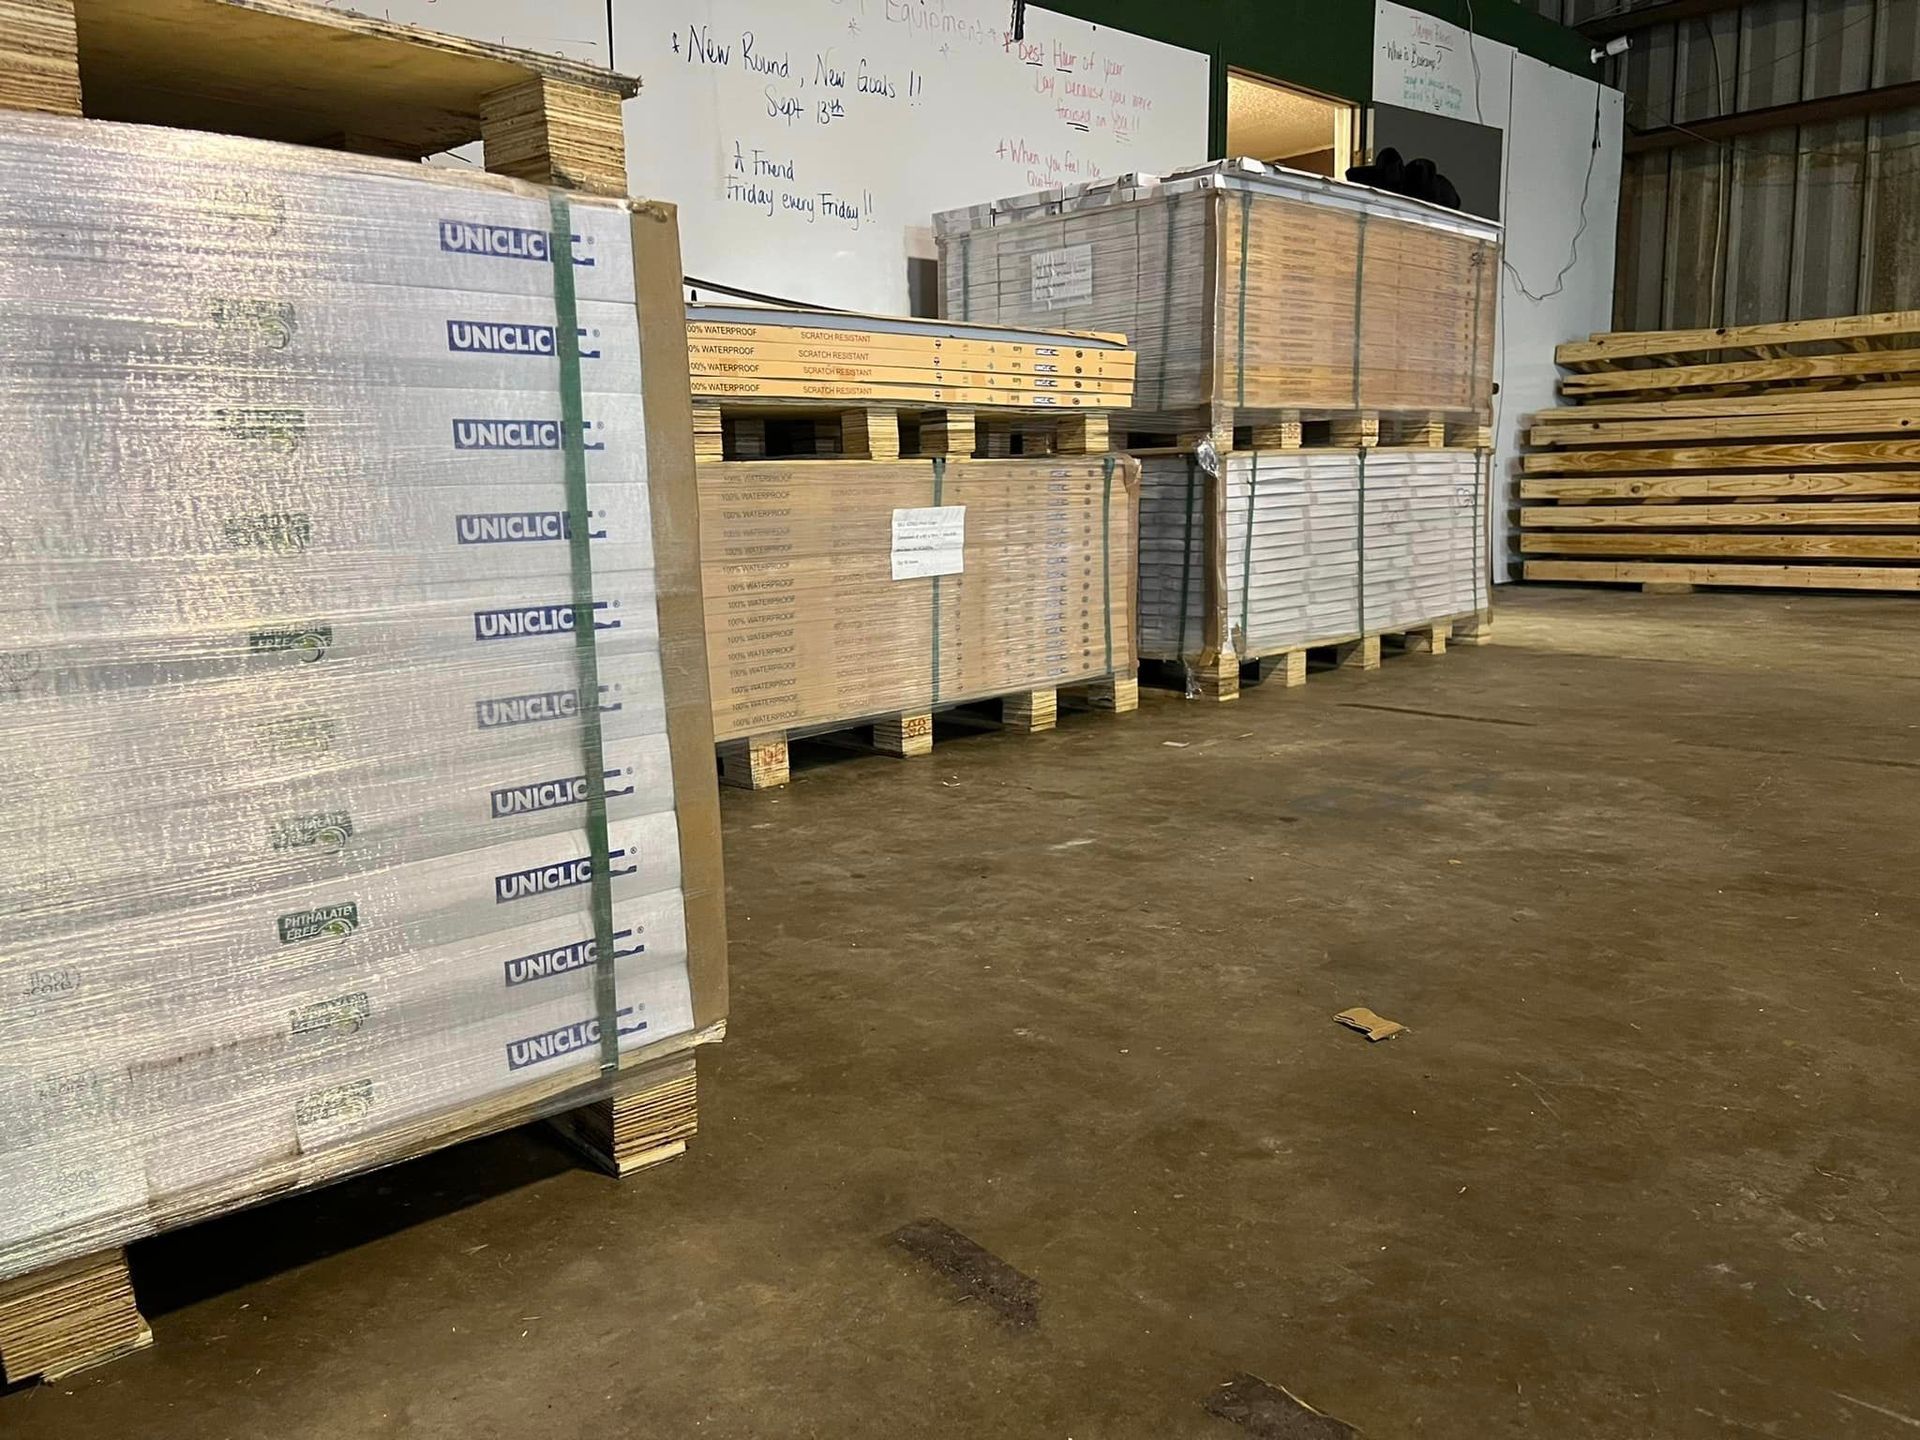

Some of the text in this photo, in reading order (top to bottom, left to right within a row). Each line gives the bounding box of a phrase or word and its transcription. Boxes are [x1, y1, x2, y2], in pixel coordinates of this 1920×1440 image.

[688, 24, 730, 65] New
[814, 48, 845, 88] New
[856, 58, 896, 98] Goals
[765, 84, 845, 126] Sept 13th
[751, 149, 795, 181] Friend
[722, 174, 773, 216] Friday
[782, 193, 815, 223] every
[817, 193, 860, 231] Friday
[444, 222, 547, 258] UNICLIC
[451, 323, 553, 353] UNICLIC
[705, 326, 757, 337] WATERPROOF
[801, 331, 871, 343] SCRATCH RESISTANT
[702, 345, 755, 355] WATERPROOF
[798, 349, 869, 361] SCRATCH RESISTANT
[707, 363, 759, 373] WATERPROOF
[803, 366, 872, 377] SCRATCH RESISTANT
[708, 383, 760, 393] WATERPROOF
[803, 385, 872, 396] SCRATCH RESISTANT
[456, 422, 556, 448] UNICLIC
[743, 509, 792, 519] WATERPROOF
[460, 514, 559, 541] UNICLIC
[746, 579, 795, 591] WATERPROOF
[748, 595, 796, 607] WATERPROOF
[479, 608, 575, 637] UNICLIC
[748, 612, 796, 625] WATERPROOF
[747, 629, 795, 642] WATERPROOF
[747, 646, 795, 659] WATERPROOF
[749, 661, 796, 675] WATERPROOF
[750, 678, 797, 692] WATERPROOF
[480, 693, 577, 726] UNICLIC
[752, 710, 799, 724] WATERPROOF
[495, 778, 588, 814] UNICLIC
[500, 860, 592, 899] UNICLIC
[284, 906, 350, 929] PHTHALATE
[286, 924, 319, 941] FREE
[508, 941, 599, 983] UNICLIC
[510, 1020, 600, 1065] UNICLIC
